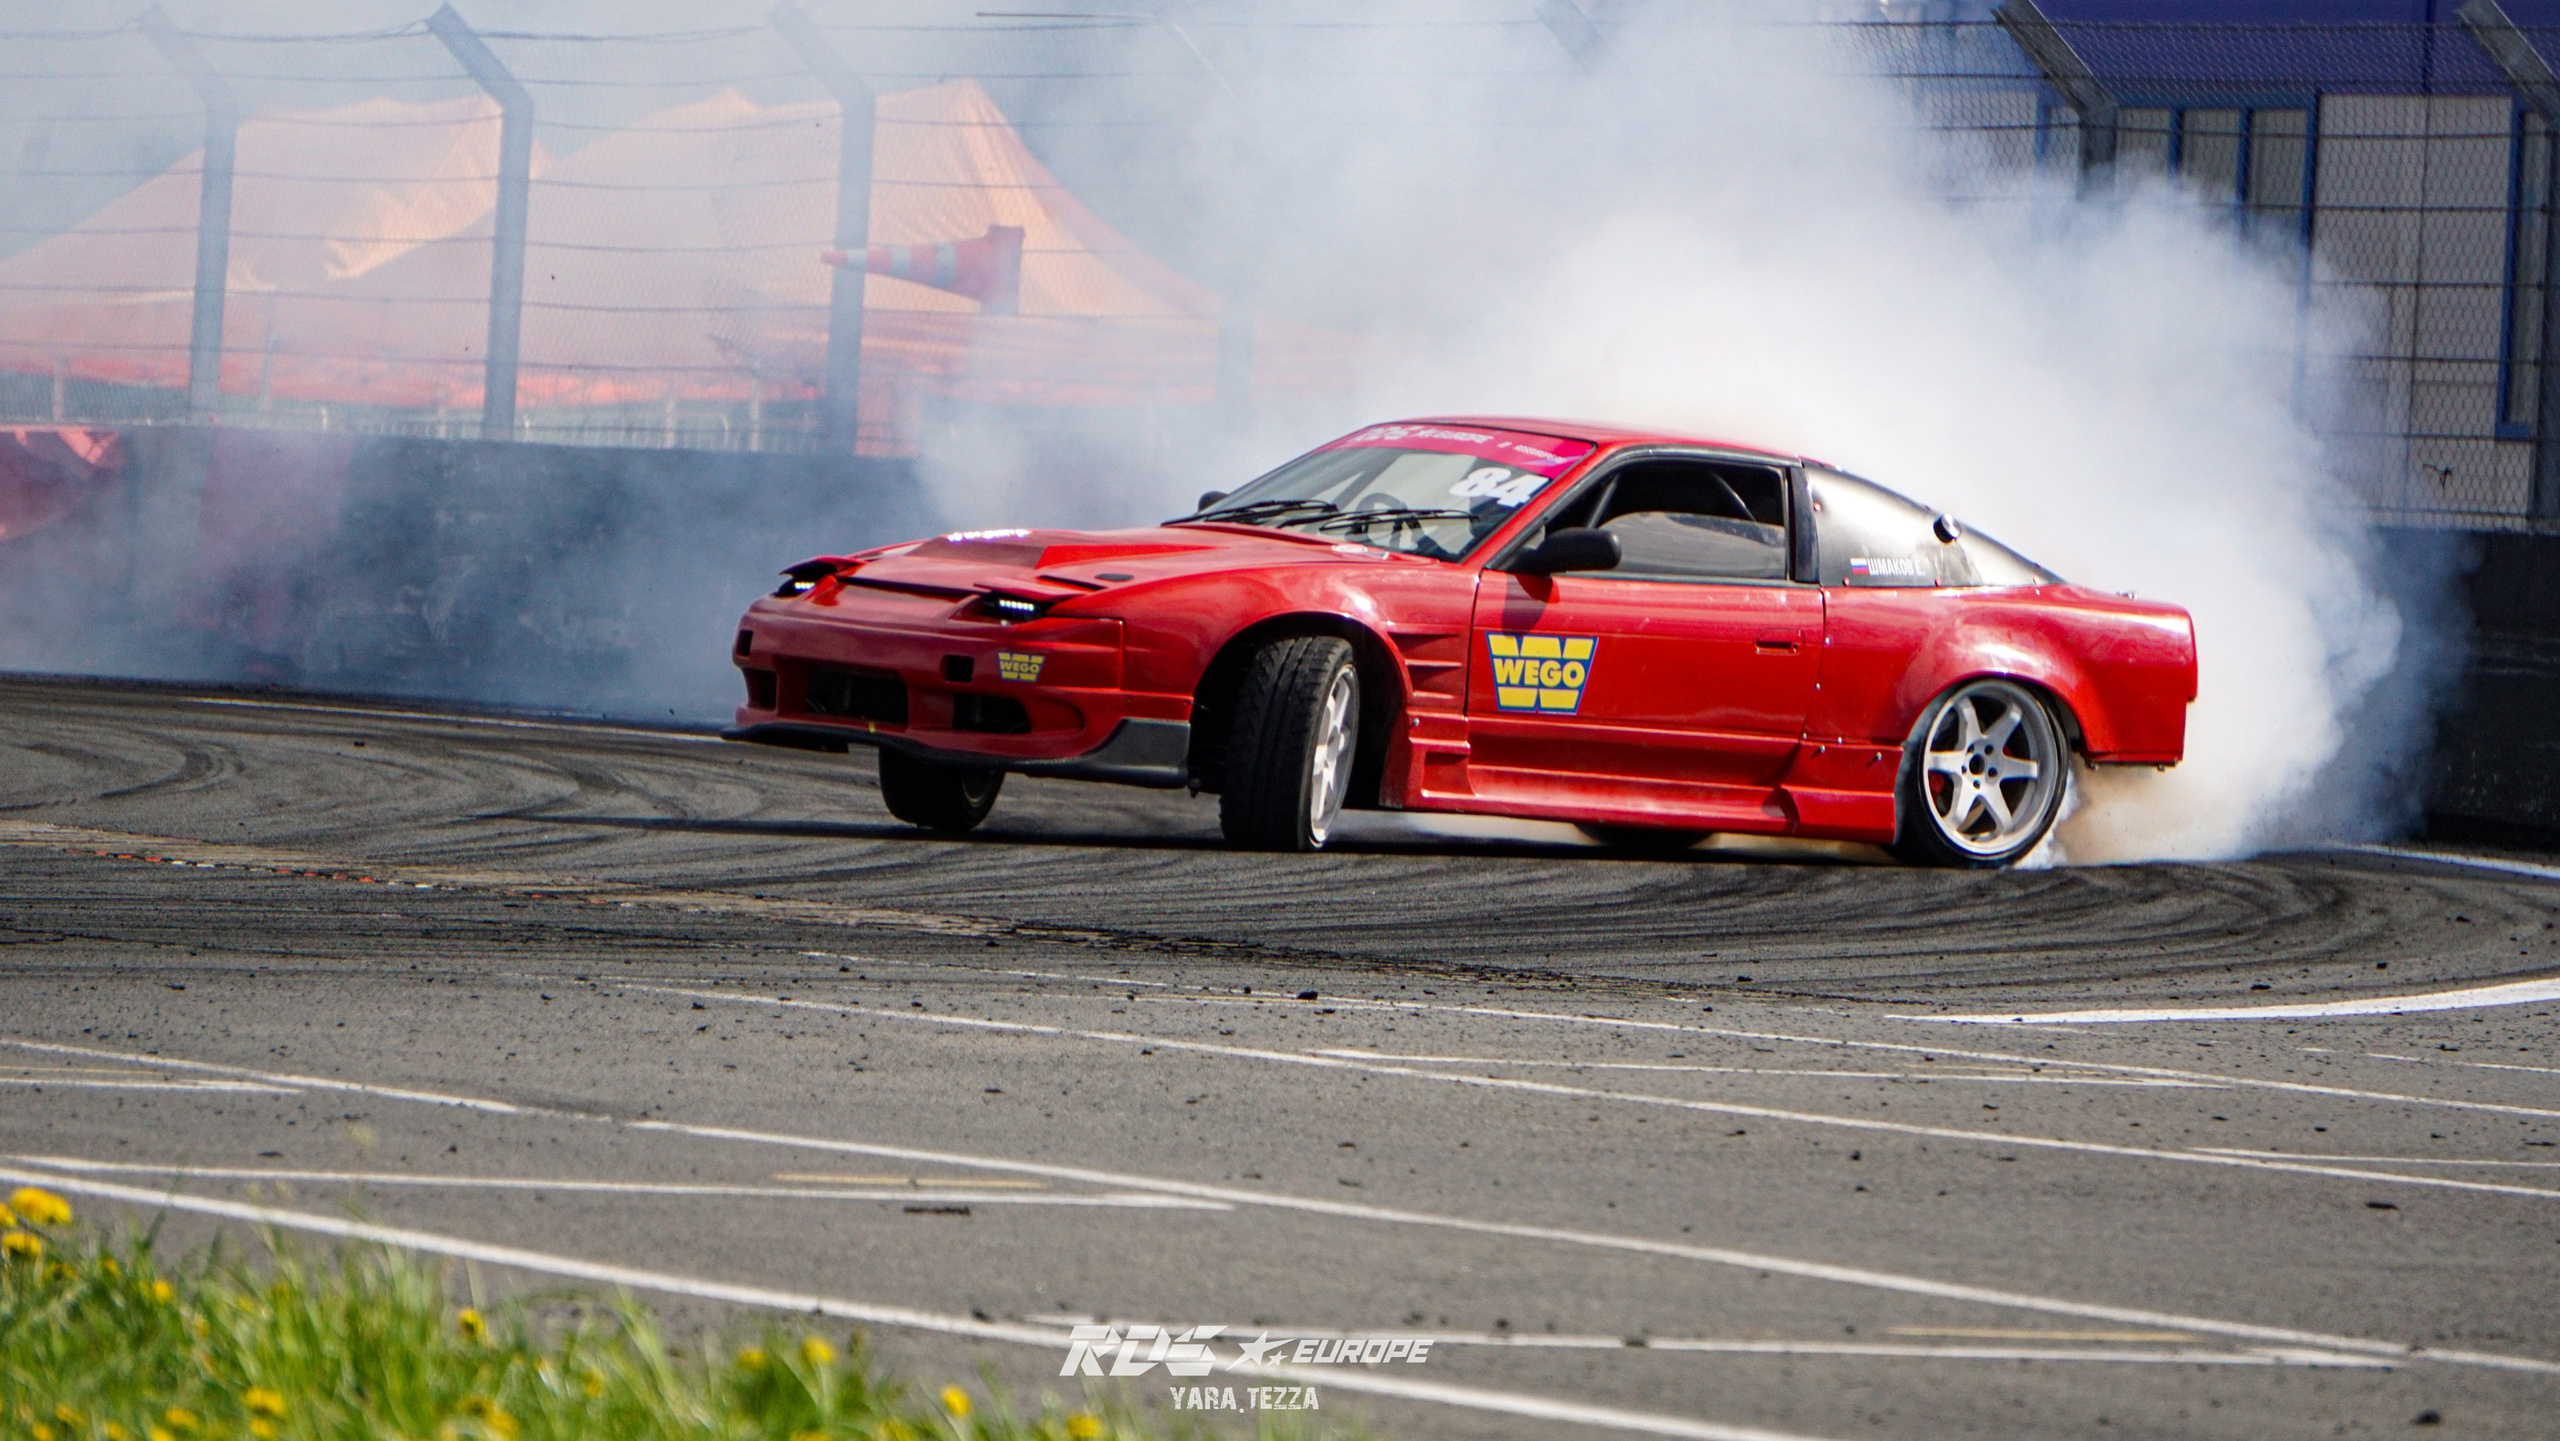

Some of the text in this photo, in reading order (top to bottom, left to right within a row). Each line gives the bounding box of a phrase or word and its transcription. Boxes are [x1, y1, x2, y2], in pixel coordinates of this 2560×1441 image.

[1448, 467, 1550, 508] 84
[1867, 557, 1915, 576] ШМАКОВ
[999, 661, 1040, 674] WEGO
[1492, 658, 1586, 689] WEGO
